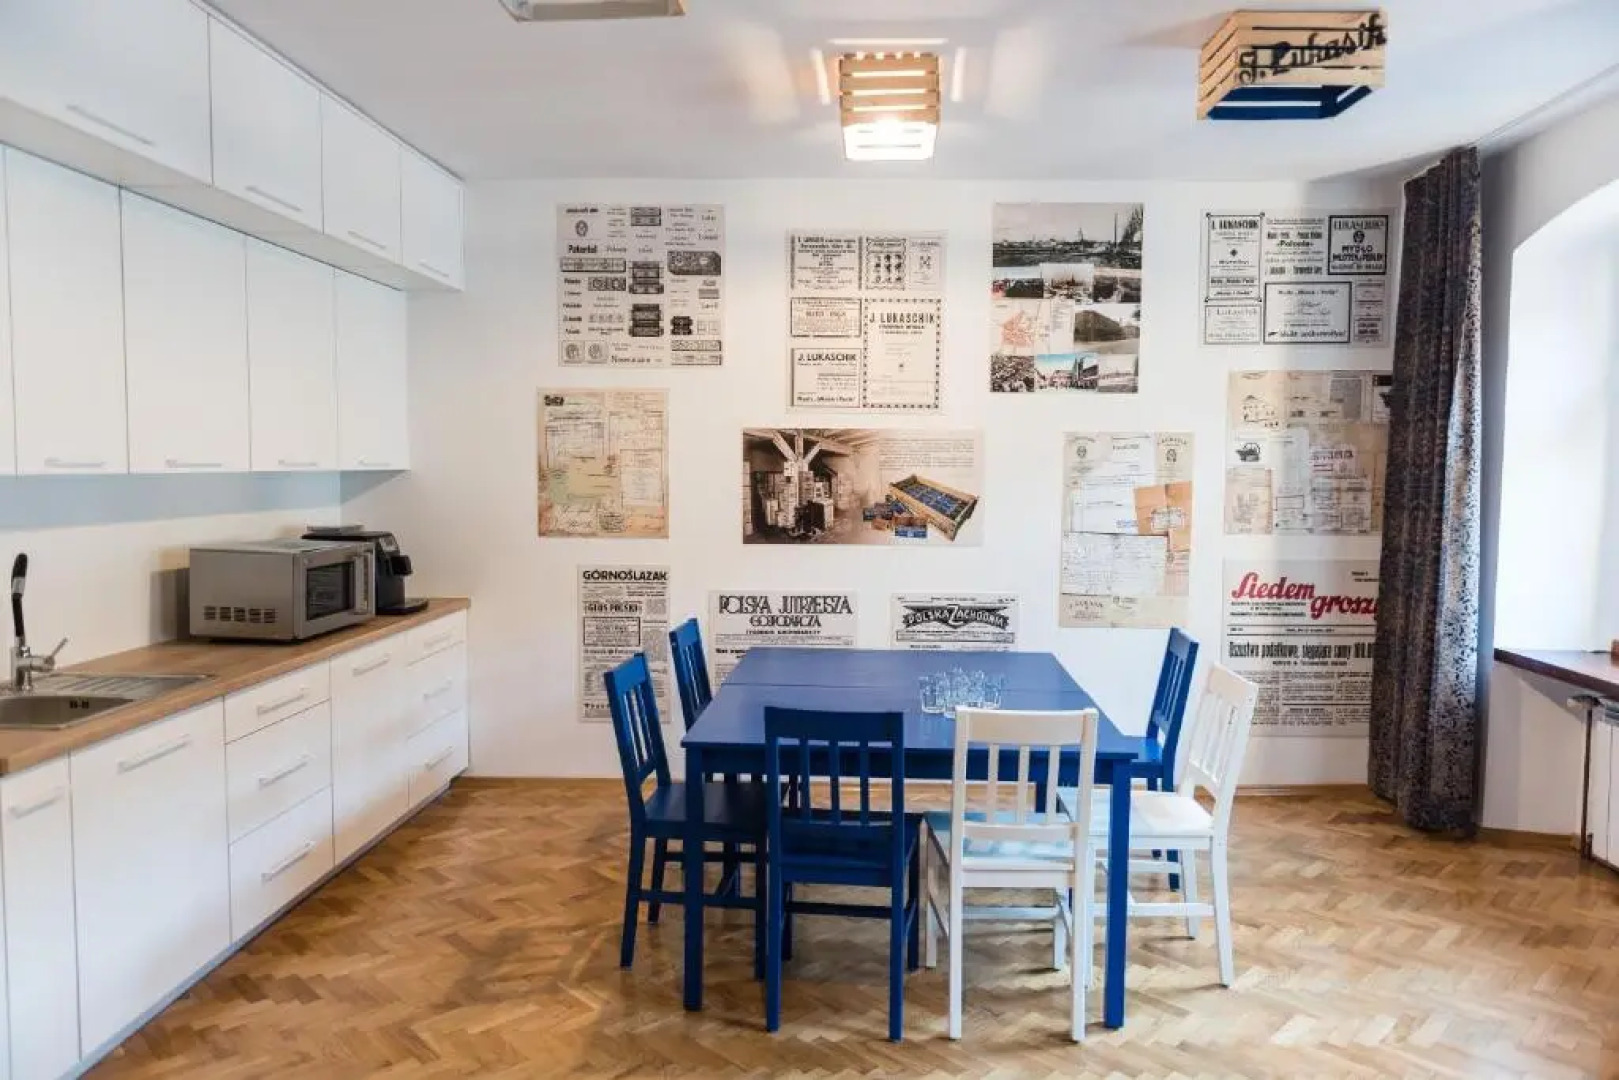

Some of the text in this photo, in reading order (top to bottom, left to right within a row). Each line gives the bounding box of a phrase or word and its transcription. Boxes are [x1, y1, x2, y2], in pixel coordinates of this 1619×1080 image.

[881, 312, 935, 324] LUKASCHIK
[807, 353, 856, 361] LUKASCHIK
[1231, 572, 1315, 599] Siedem
[719, 595, 772, 614] POLSKA
